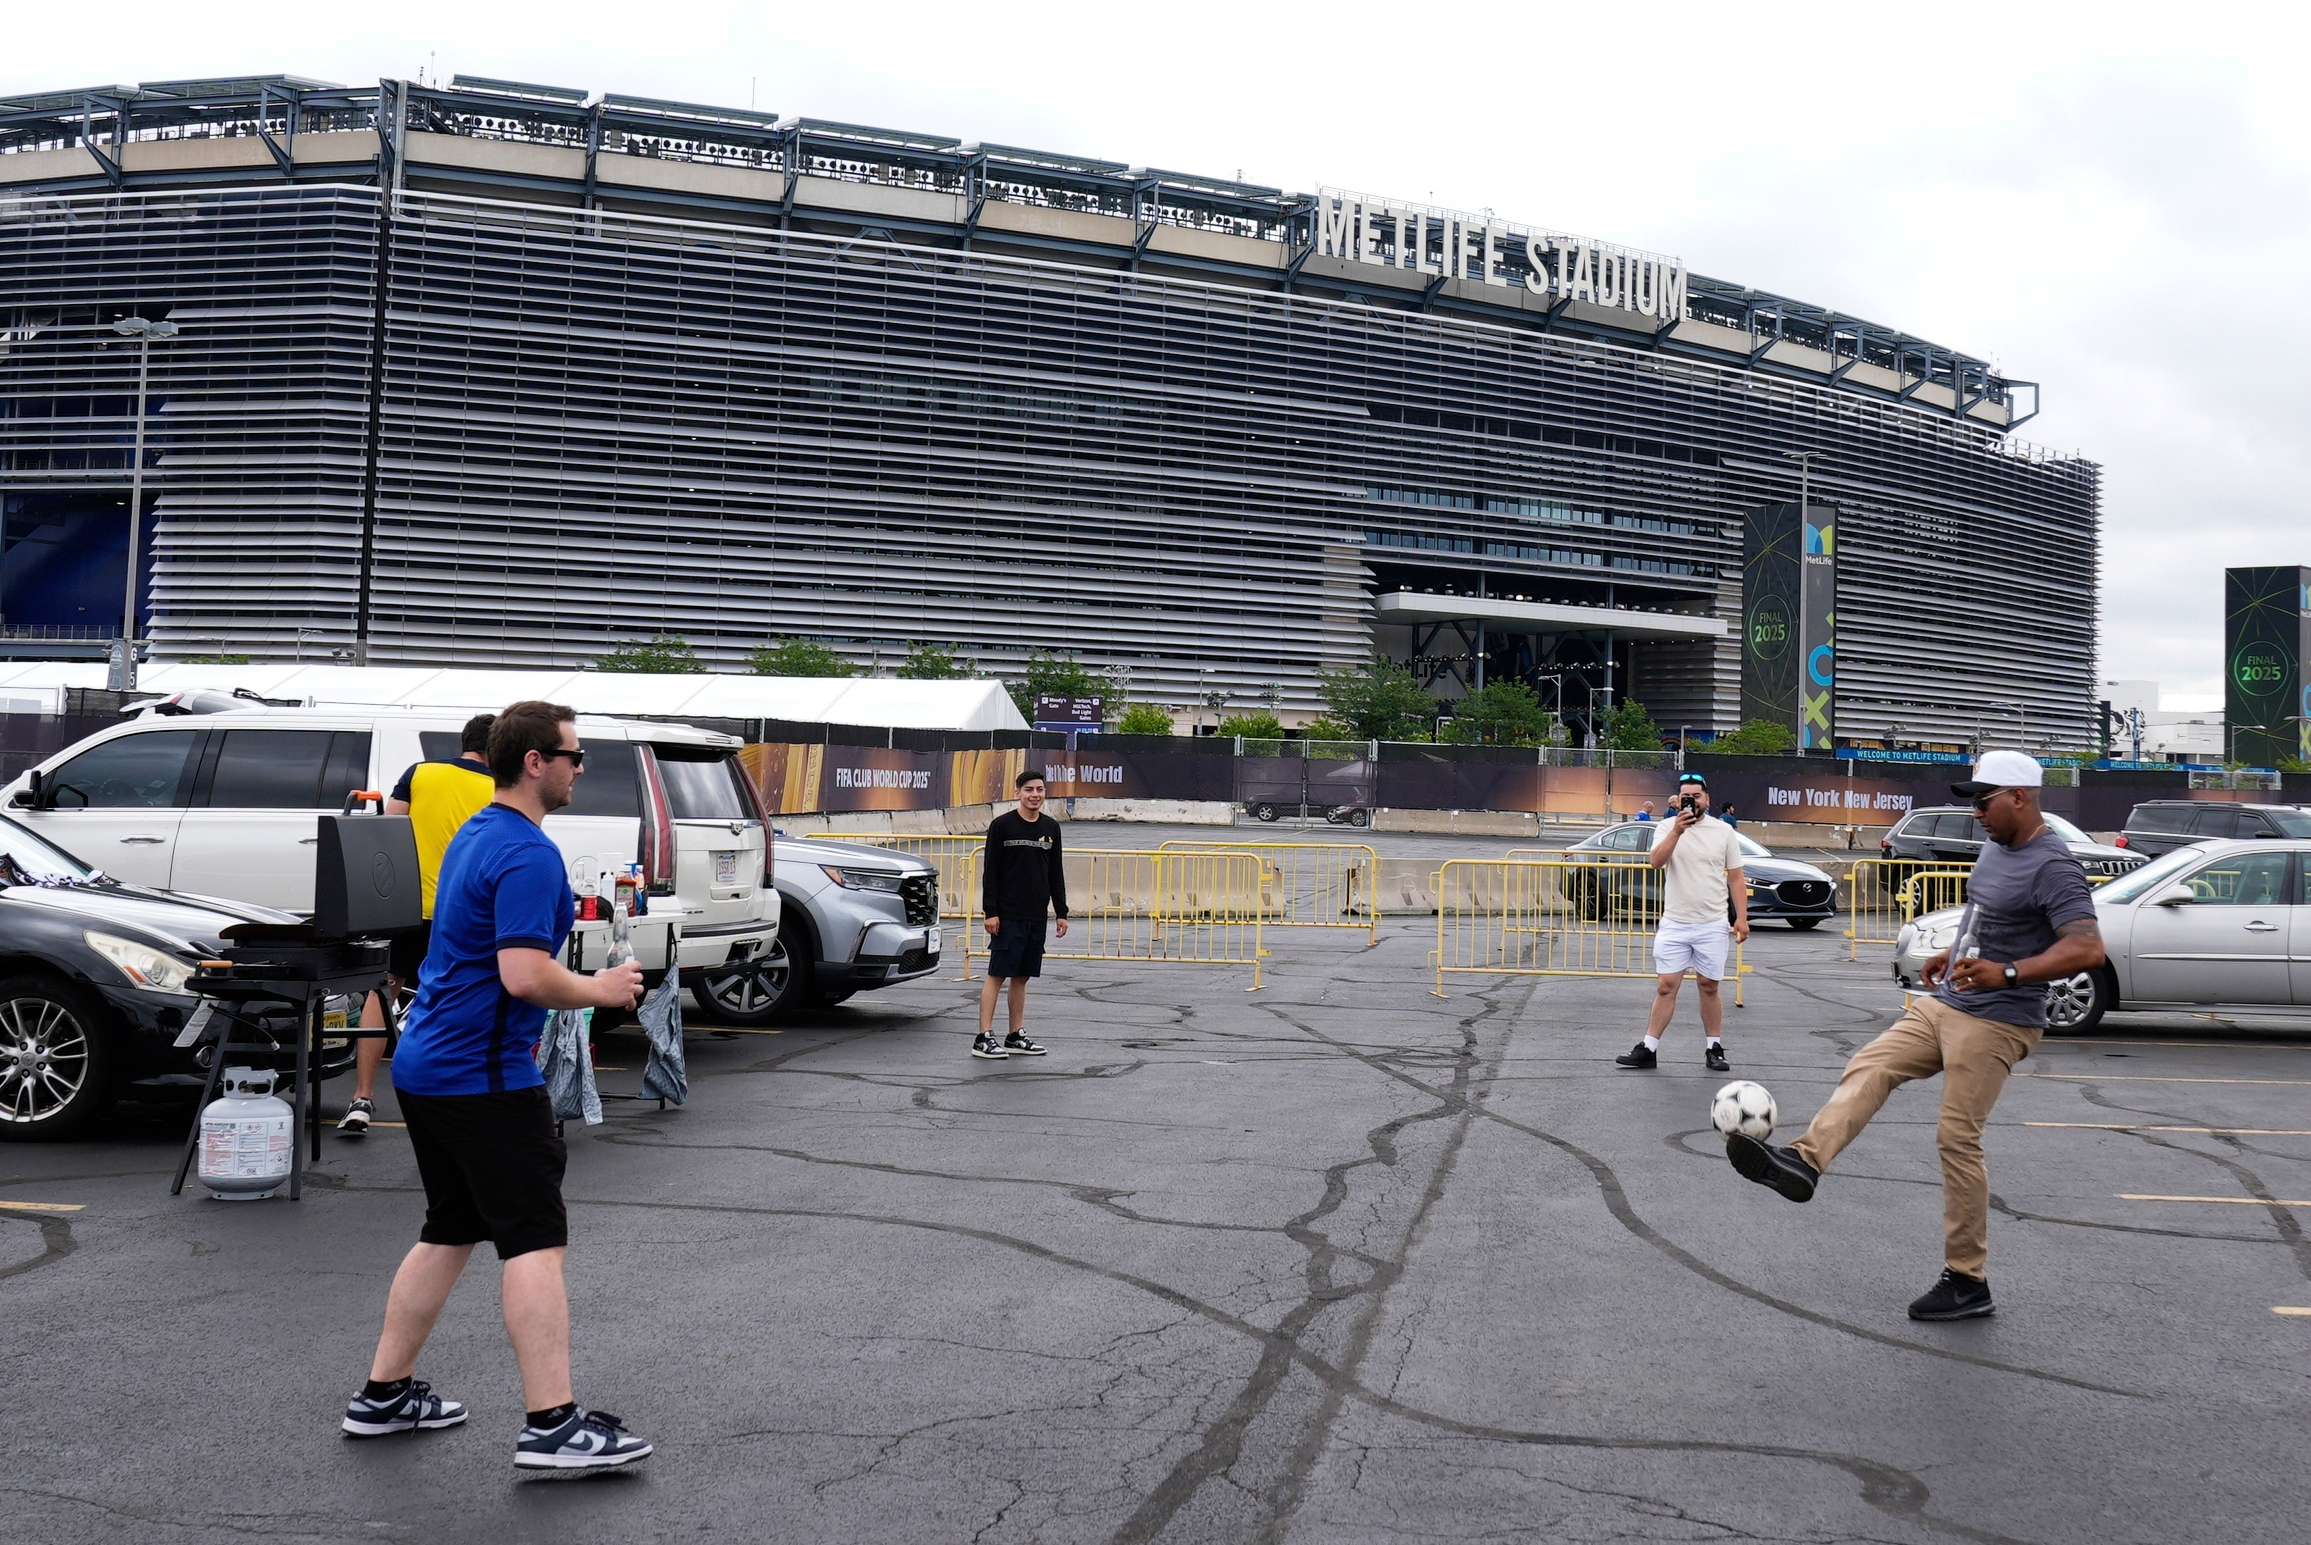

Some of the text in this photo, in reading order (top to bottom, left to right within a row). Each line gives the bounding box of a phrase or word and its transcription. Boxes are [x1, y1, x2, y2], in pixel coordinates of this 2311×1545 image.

[1317, 194, 1687, 323] METLIFE STADIUM
[1805, 555, 1832, 566] MetLife
[1759, 611, 1782, 623] FINAL
[1755, 624, 1785, 643] 2025
[131, 647, 137, 662] G
[2247, 655, 2277, 665] FINAL
[130, 672, 135, 686] 5
[2241, 666, 2281, 681] 2025
[1857, 750, 1961, 762] WELCOME TO METLIFE STADIUM
[836, 768, 852, 787] FIFA
[853, 768, 872, 788] CLUB
[873, 769, 898, 788] WORLD
[899, 770, 912, 788] CUP
[1080, 765, 1123, 783] World
[1768, 787, 1913, 814] New York New Jersey
